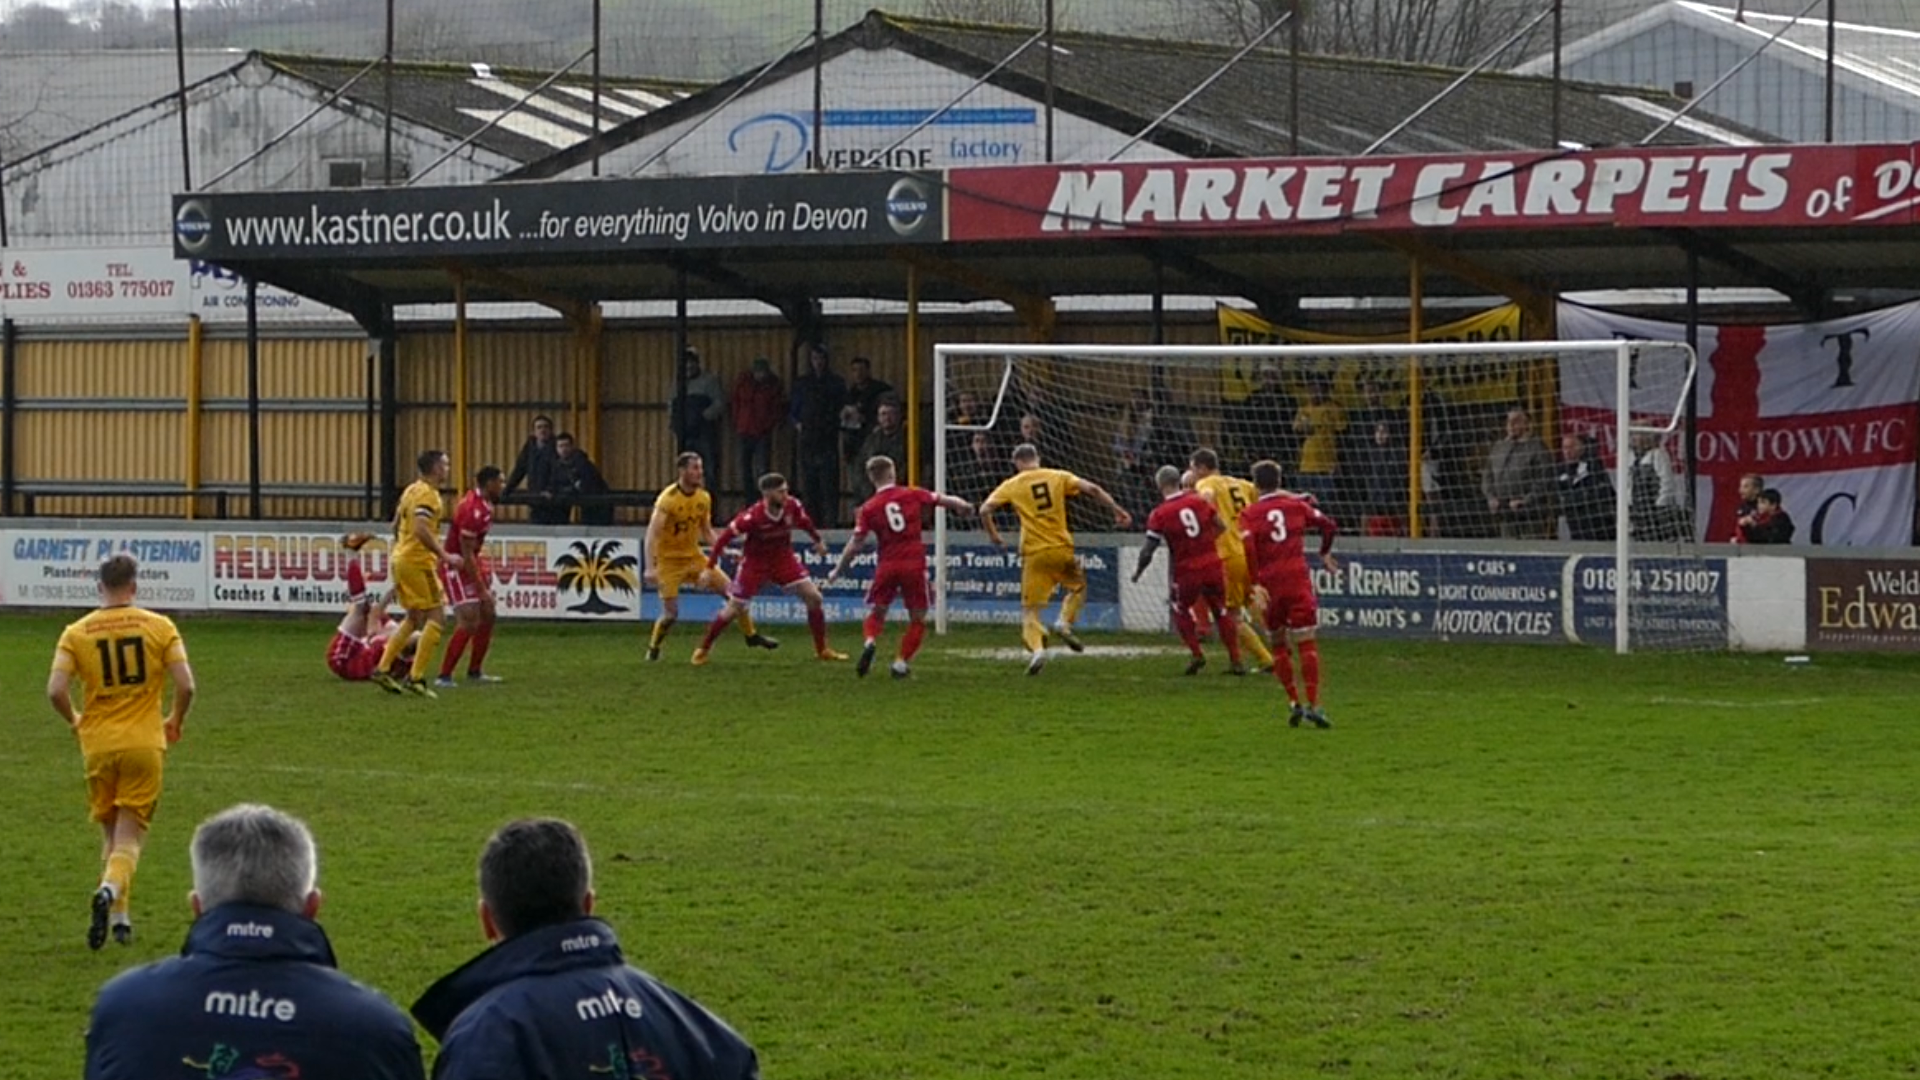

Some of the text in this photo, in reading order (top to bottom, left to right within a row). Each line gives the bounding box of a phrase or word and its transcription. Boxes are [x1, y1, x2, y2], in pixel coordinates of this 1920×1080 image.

[949, 137, 1022, 163] factory
[1041, 163, 1395, 231] MARKET
[1409, 153, 1792, 227] CARPETS
[1806, 176, 1852, 218] of
[889, 201, 927, 212] VOLVO
[225, 198, 511, 247] www.kastner.co.uk
[574, 206, 690, 243] everything
[697, 203, 758, 234] Volvo
[765, 203, 785, 231] in
[792, 202, 868, 231] Devon
[67, 280, 175, 298] 01363 775017
[224, 294, 300, 308] CONTIONING
[1820, 327, 1869, 388] T
[1749, 428, 1854, 462] TOWN
[1864, 418, 1905, 452] FC
[1031, 482, 1054, 511] 9
[885, 502, 905, 532] 6
[1178, 507, 1200, 538] 9
[1267, 509, 1287, 542] 3
[14, 538, 91, 561] GARNETT
[964, 551, 1004, 568] Town
[1478, 560, 1506, 577] CARS
[1583, 567, 1720, 594] 0184 251007
[214, 585, 265, 602] Coaches
[272, 586, 281, 602] &
[1438, 585, 1546, 600] LIGHT COMMERCIALS
[1359, 606, 1406, 629] MOT'S
[1819, 584, 1920, 631] Edwa
[1431, 609, 1553, 635] MOTORCYCLES
[96, 636, 146, 688] 10
[227, 922, 274, 938] mitre
[561, 934, 600, 952] mitre
[205, 990, 296, 1021] mitre
